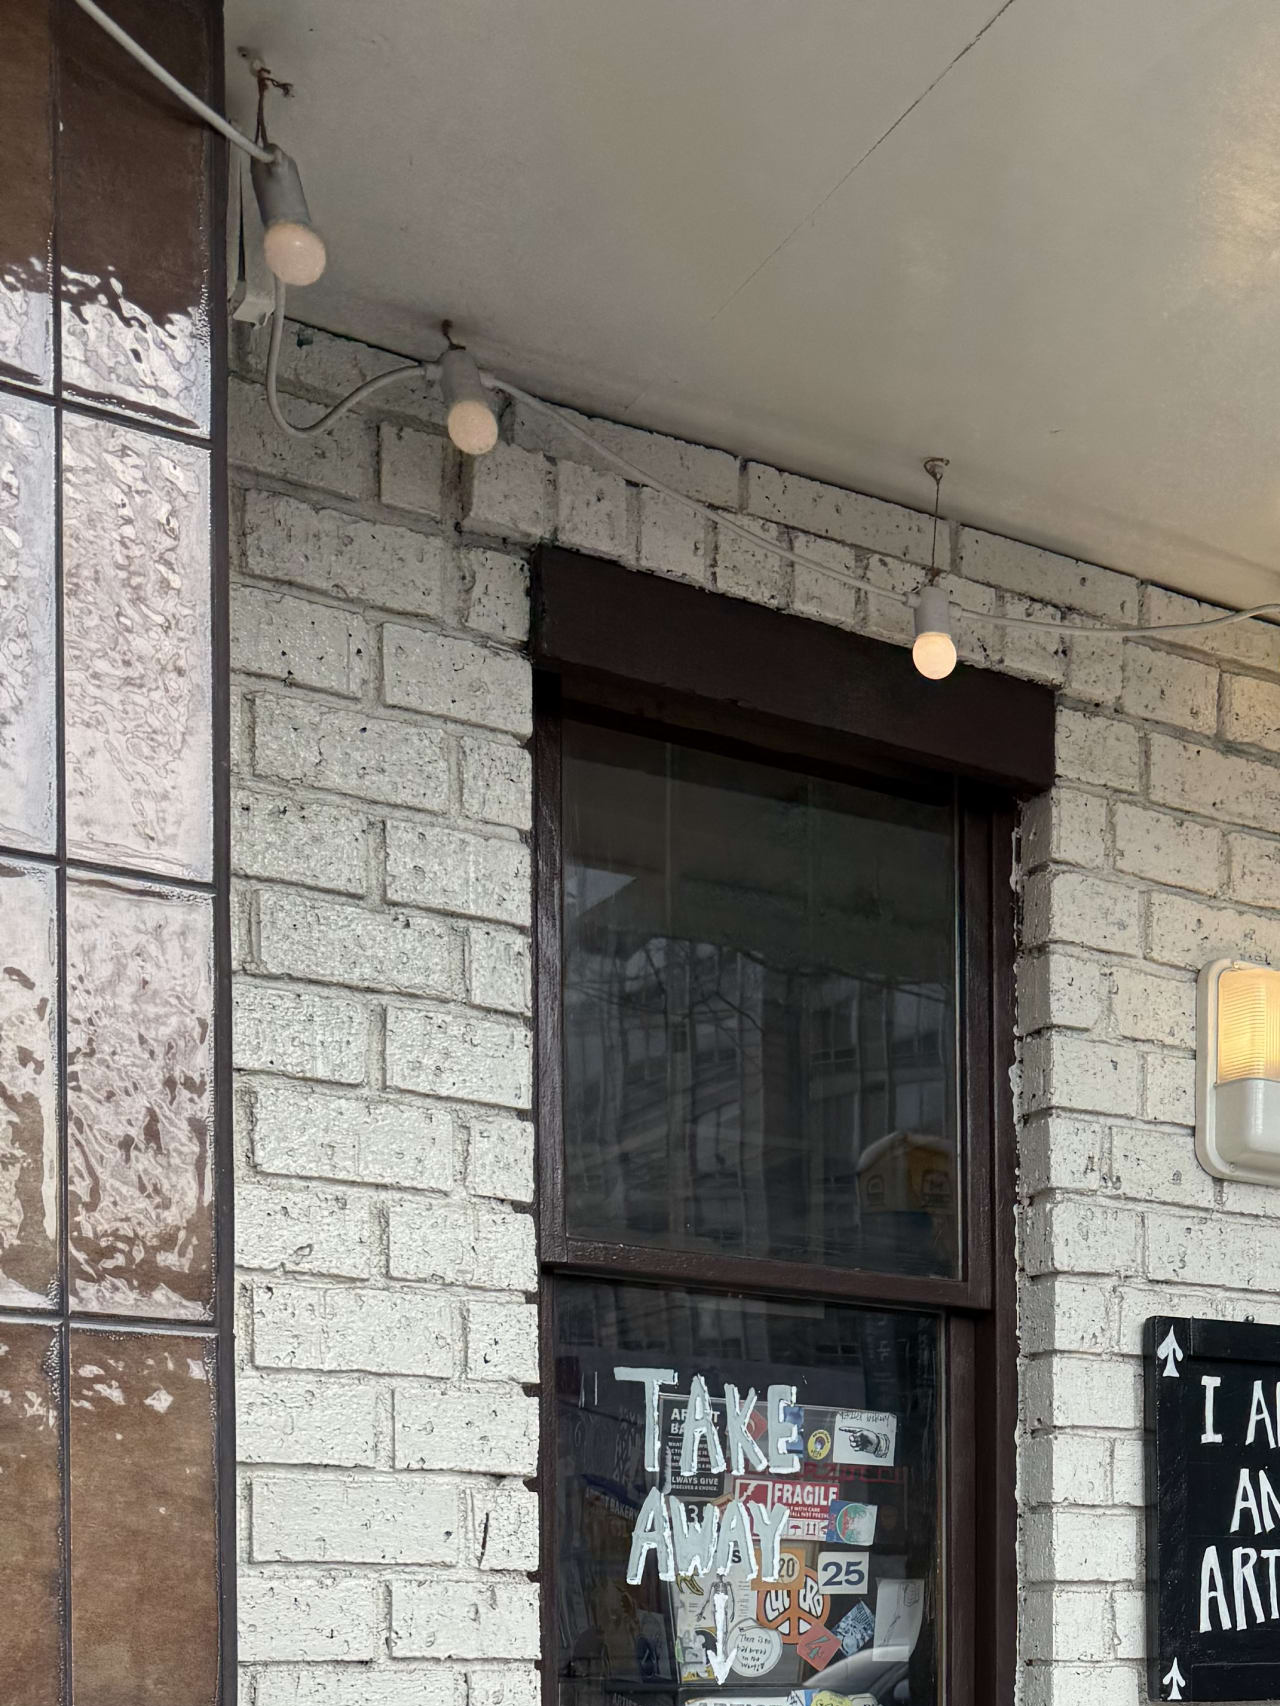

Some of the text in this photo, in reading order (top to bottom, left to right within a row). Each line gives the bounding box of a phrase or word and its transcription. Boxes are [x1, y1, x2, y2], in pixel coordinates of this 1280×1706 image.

[614, 1366, 800, 1475] TAKE
[1200, 1375, 1223, 1444] I
[627, 1486, 789, 1585] AWAY
[821, 1560, 865, 1587] 25
